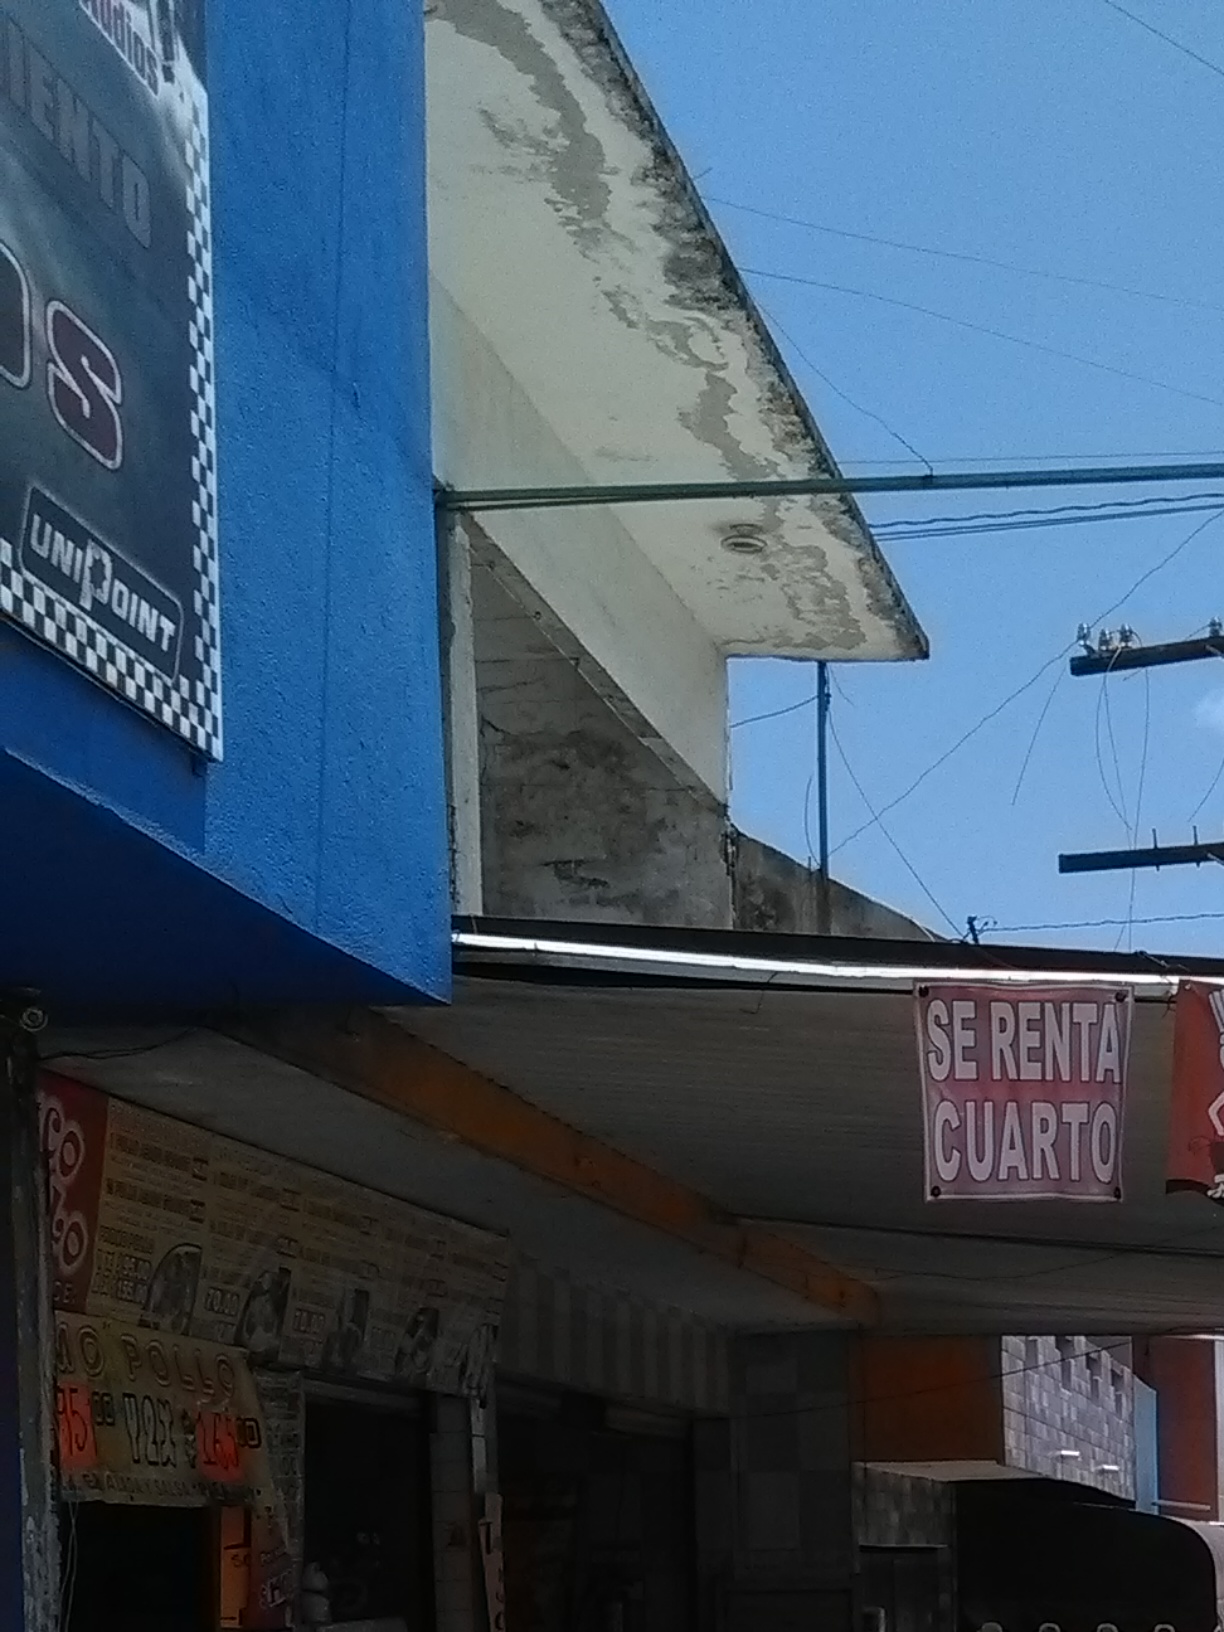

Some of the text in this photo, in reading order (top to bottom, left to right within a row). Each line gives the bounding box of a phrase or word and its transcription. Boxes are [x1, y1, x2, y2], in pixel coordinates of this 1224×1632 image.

[81, 0, 159, 97] udios
[0, 8, 152, 249] IENTO
[927, 1000, 1121, 1086] SE RENTA
[933, 1100, 1118, 1183] CUARTO
[120, 1332, 235, 1399] POLLO
